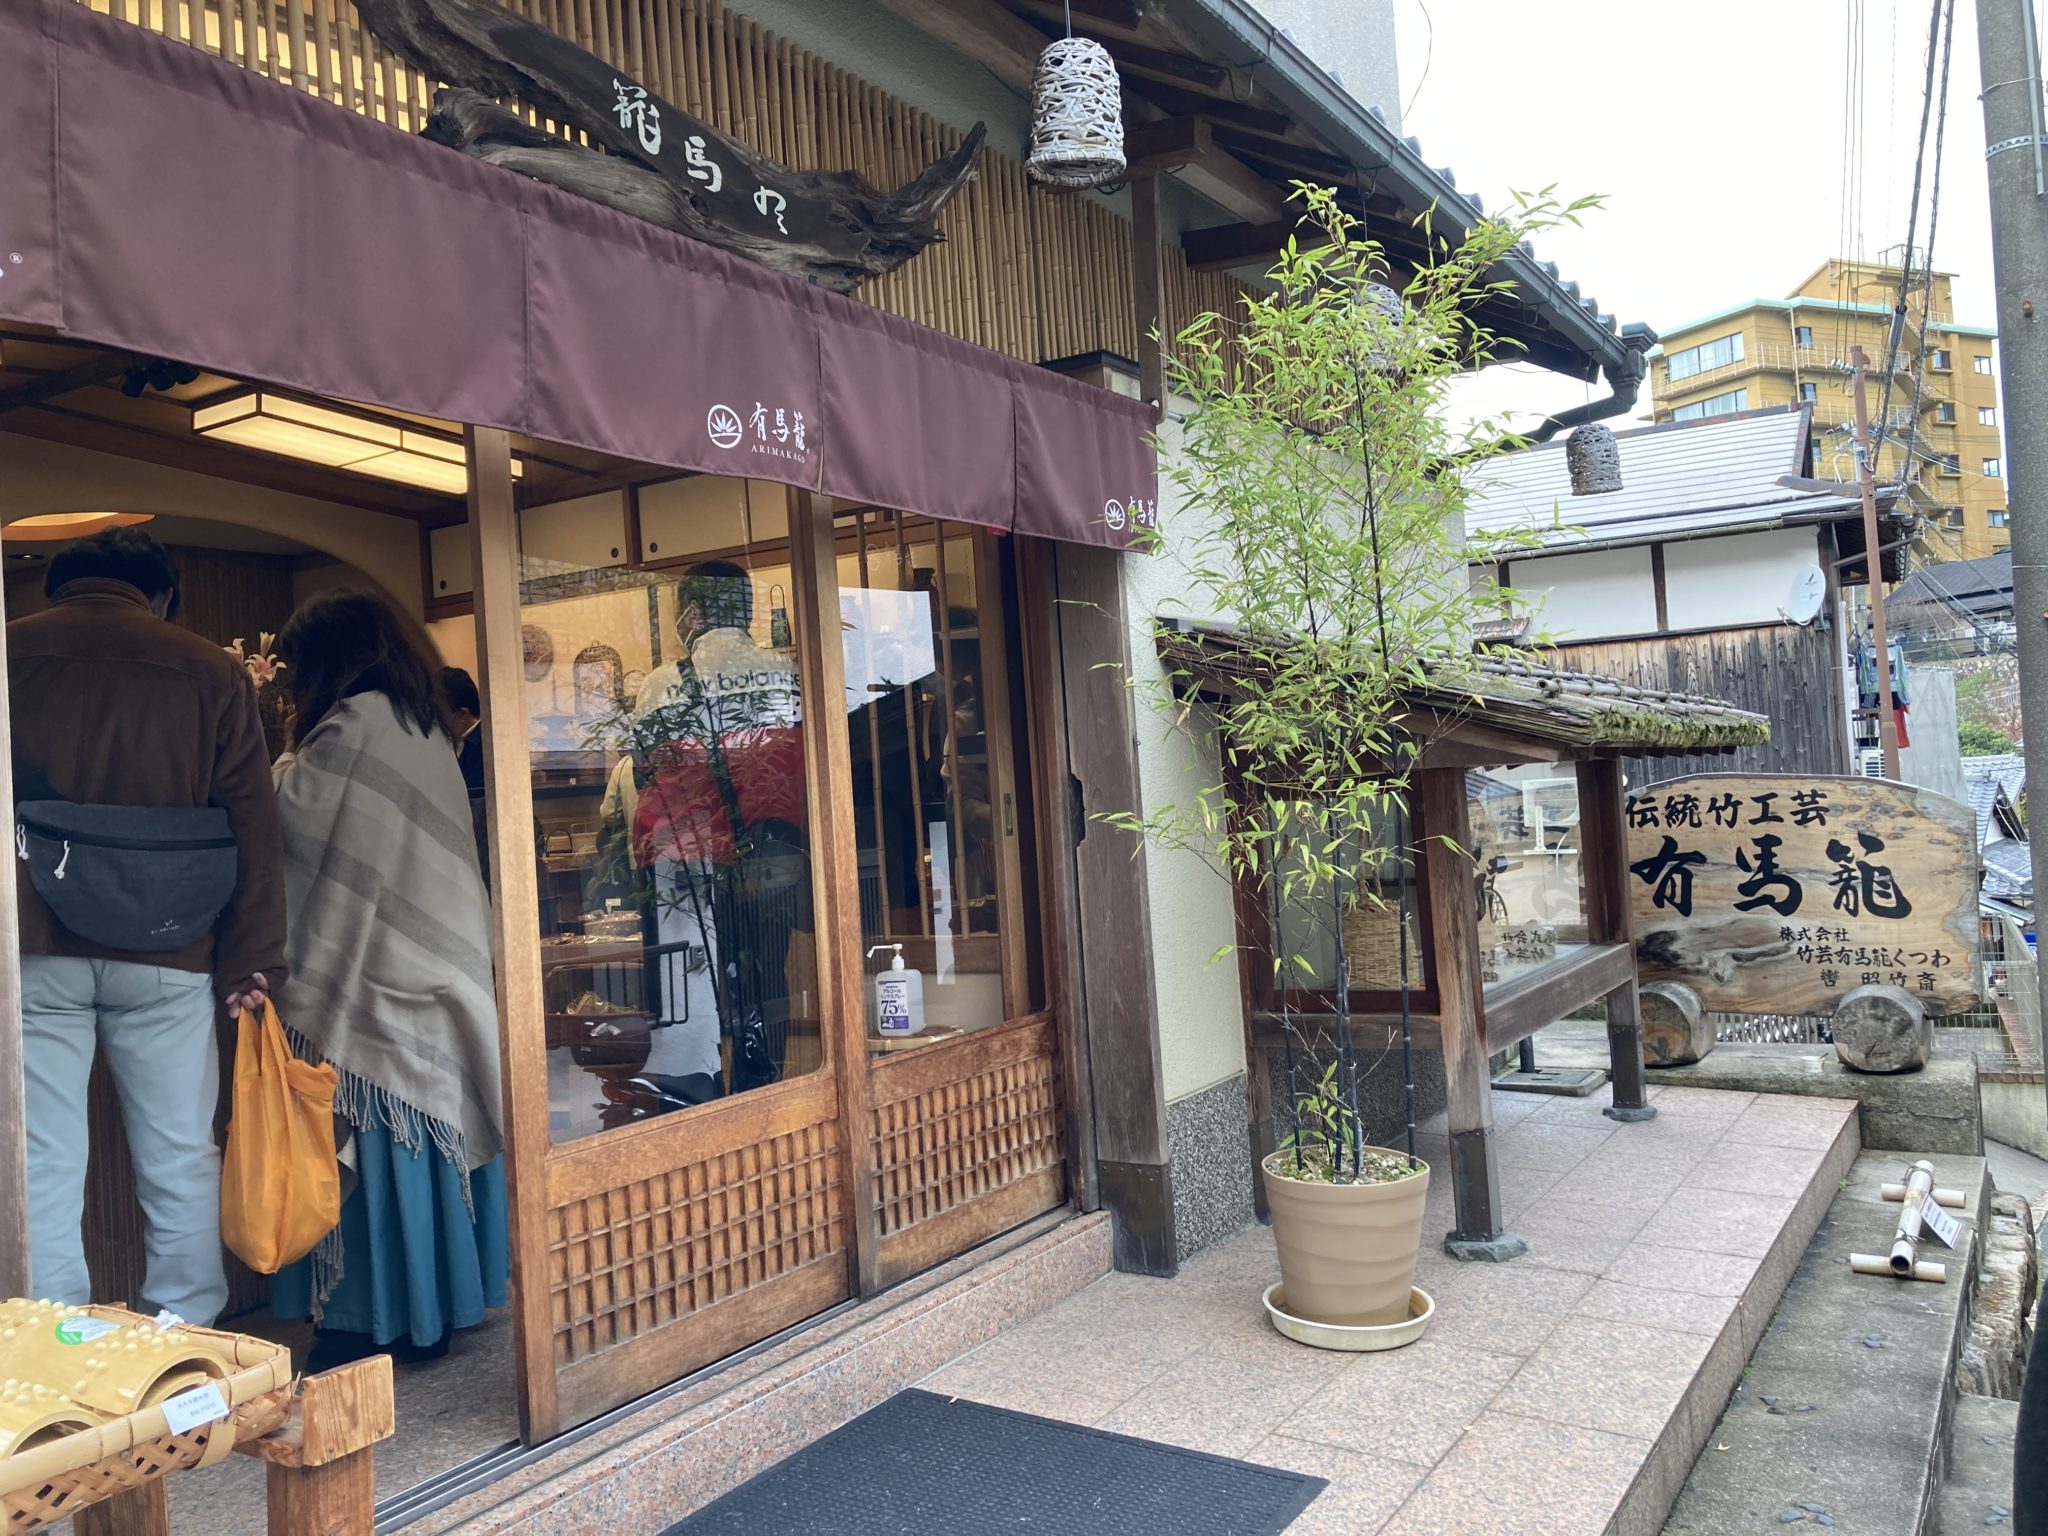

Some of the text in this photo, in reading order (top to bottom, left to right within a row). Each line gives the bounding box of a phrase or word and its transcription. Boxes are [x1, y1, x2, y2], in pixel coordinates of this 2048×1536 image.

[751, 444, 805, 463] ARIMAKAGO
[1625, 789, 1830, 829] 伝統竹工芸
[1630, 831, 1912, 919] 有馬籠
[1779, 926, 1851, 942] 株式会社
[1797, 945, 1951, 968] 竹芸有馬籠くつわ
[881, 1000, 907, 1014] 75%
